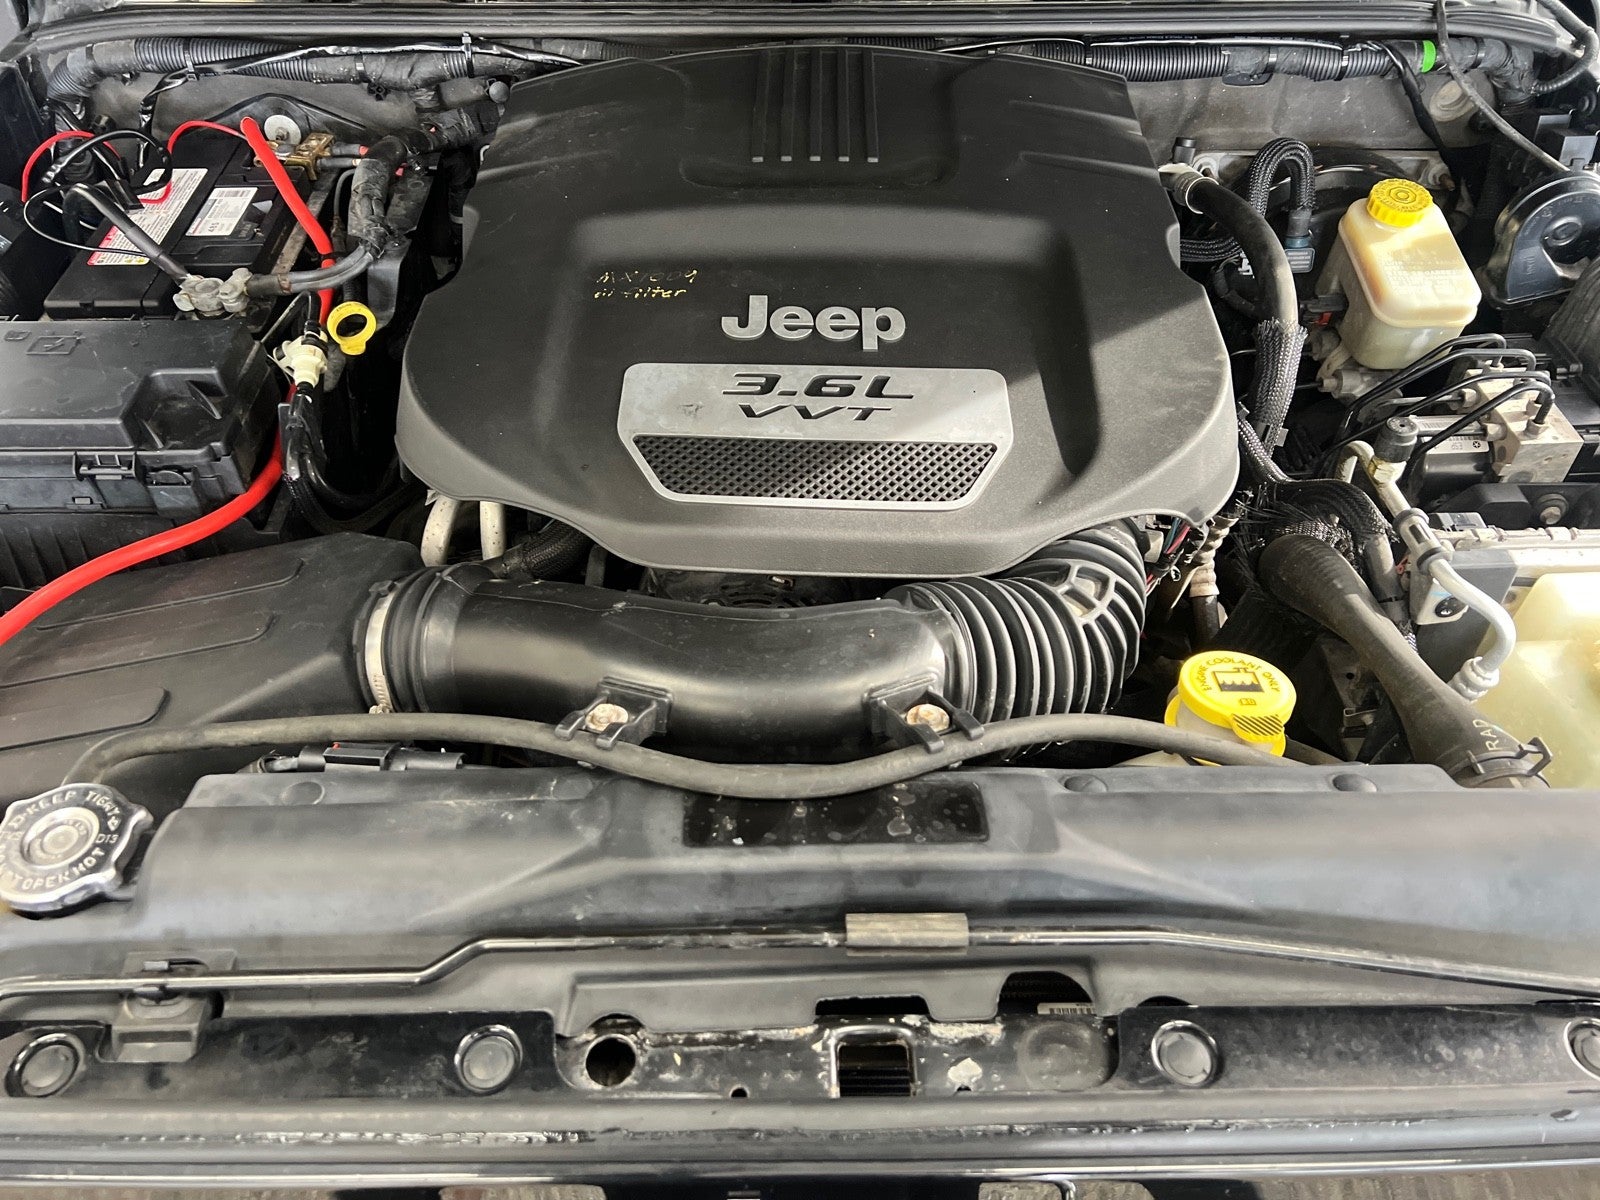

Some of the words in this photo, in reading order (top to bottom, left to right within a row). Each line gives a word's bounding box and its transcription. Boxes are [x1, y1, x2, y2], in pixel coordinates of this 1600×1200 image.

[721, 295, 906, 352] Jeep
[722, 372, 914, 400] 3.6L
[738, 404, 893, 421] VVT
[1197, 664, 1213, 692] ENGINE
[1206, 657, 1262, 671] COOLANT
[1262, 671, 1280, 692] ONLY
[1472, 719, 1500, 751] RAD
